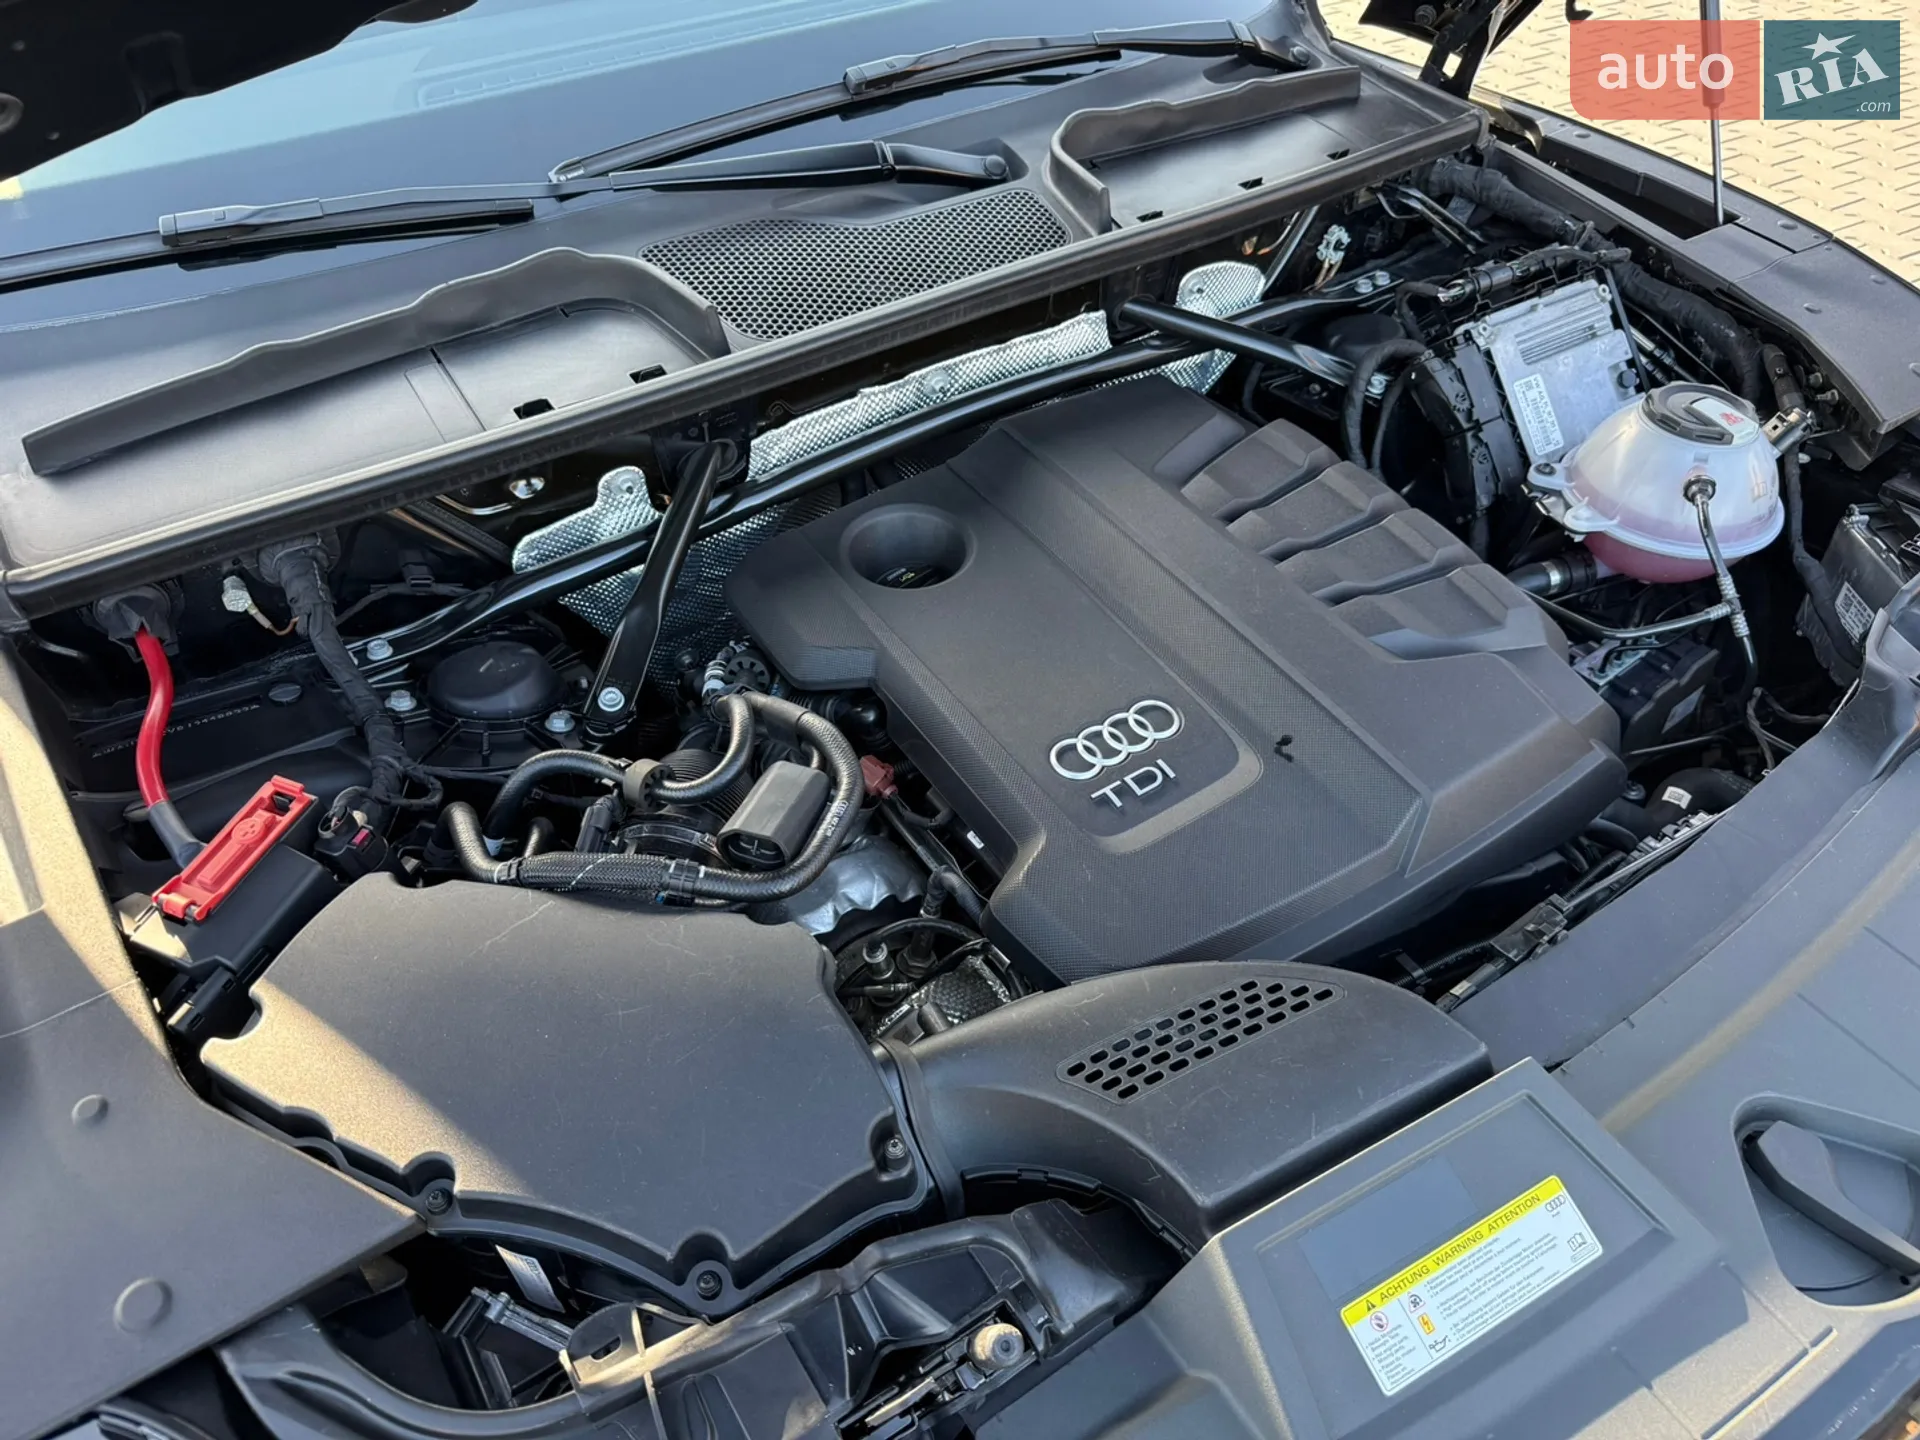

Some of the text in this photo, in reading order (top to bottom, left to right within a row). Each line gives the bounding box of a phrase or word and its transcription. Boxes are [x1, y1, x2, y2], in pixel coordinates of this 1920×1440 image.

[1090, 758, 1176, 808] TDI
[1379, 1265, 1430, 1303] ACHTUNG
[1432, 1230, 1484, 1268] WARNING
[1487, 1193, 1541, 1233] ATTENTION
